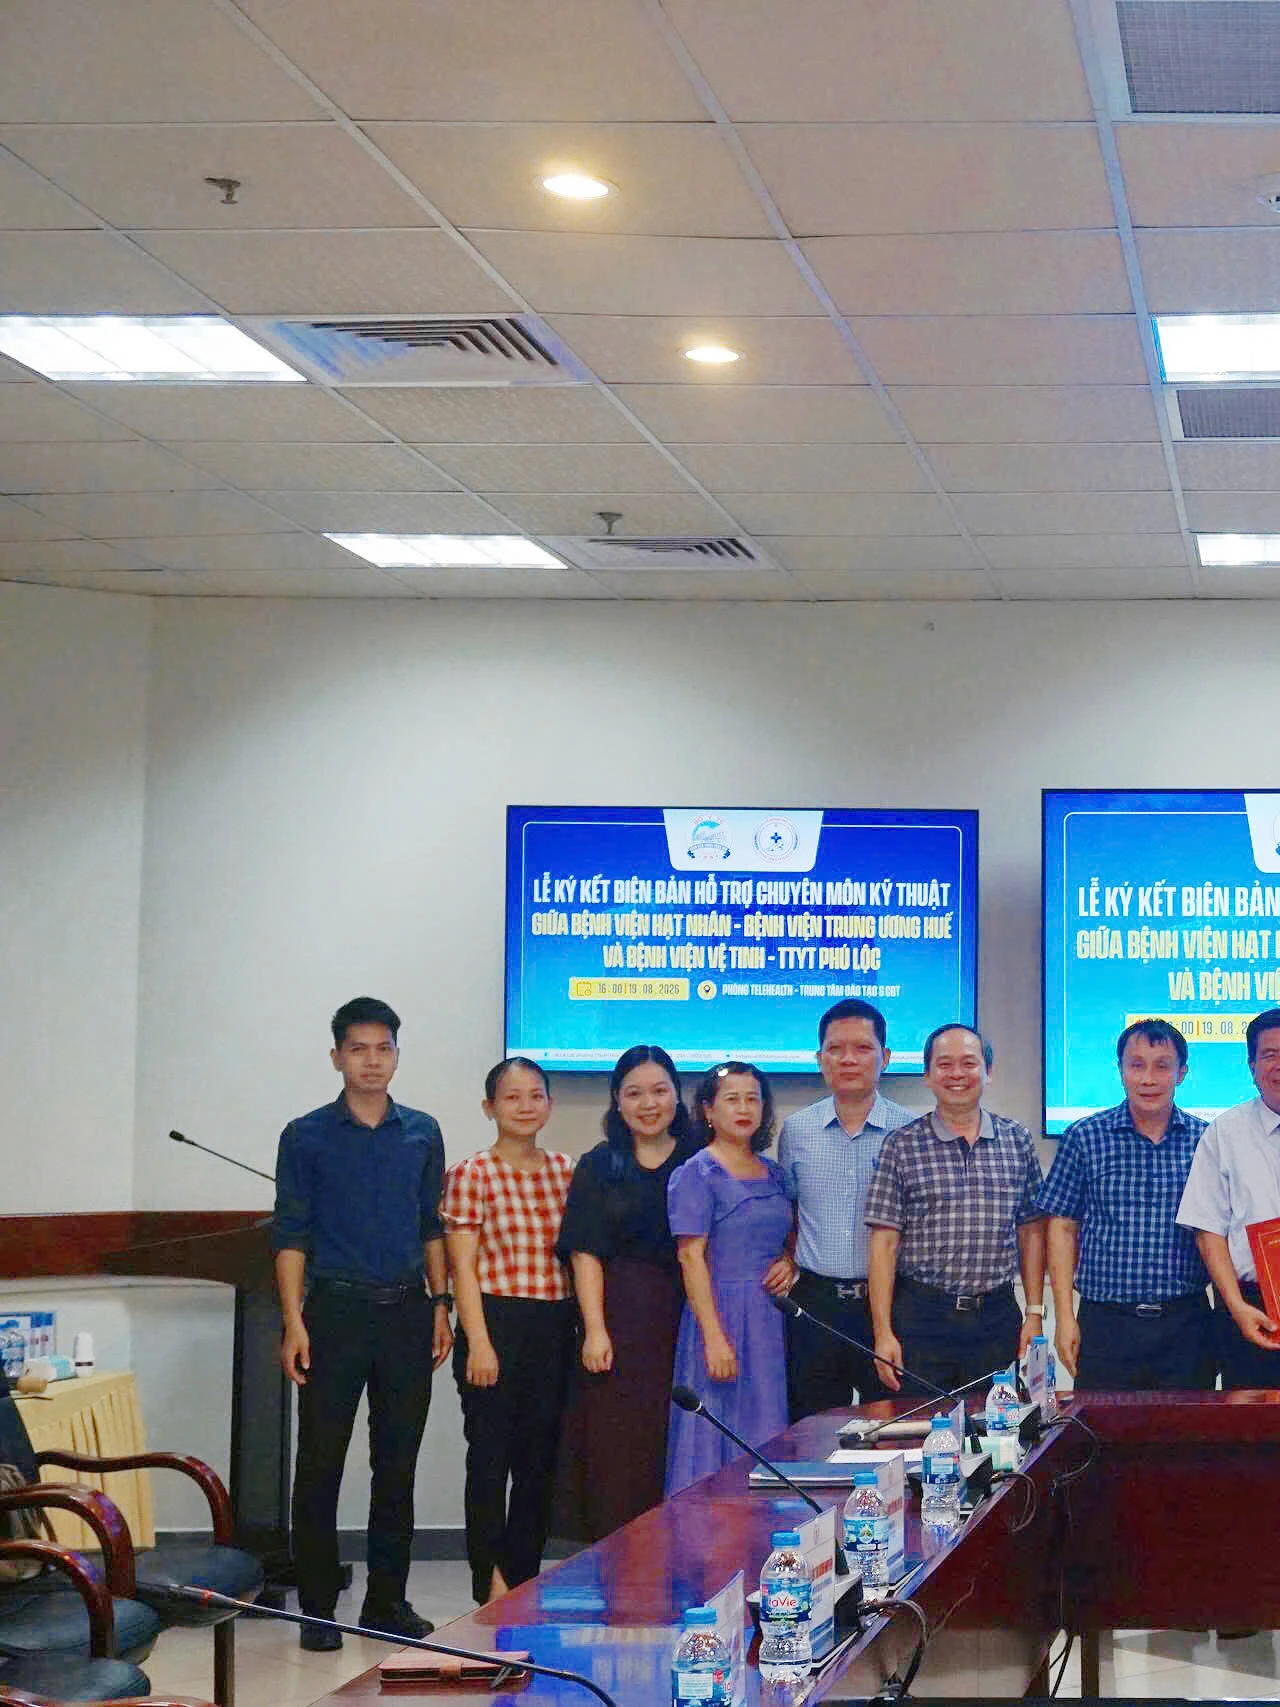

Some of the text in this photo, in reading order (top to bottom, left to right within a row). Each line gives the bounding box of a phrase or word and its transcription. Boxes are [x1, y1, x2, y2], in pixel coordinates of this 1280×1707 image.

[533, 872, 950, 910] LỄ KÝ KẾT BIÊN BẢN HỖ TRỢ CHUYÊN MÔN KỸ THUẬT
[1078, 877, 1100, 917] LỄ
[1105, 881, 1133, 917] KÝ
[1138, 879, 1177, 917] KẾT
[1181, 881, 1229, 917] BIÊN
[1235, 880, 1280, 917] BẢN
[531, 909, 569, 936] GIỮA
[571, 909, 612, 939] BỆNH
[614, 909, 650, 940] VIỆN
[652, 914, 684, 940] HẠT
[685, 910, 732, 937] NHÂN
[744, 911, 785, 941] BỆNH
[787, 912, 822, 941] VIỆN
[824, 916, 875, 938] TRUNG
[878, 914, 921, 939] ƯƠNG
[923, 911, 954, 939] HUẾ
[603, 942, 624, 969] VÀ
[626, 942, 667, 972] BỆNH
[669, 942, 705, 972] VIỆN
[707, 943, 727, 972] VỆ
[728, 946, 766, 969] TINH
[778, 947, 816, 970] TTYT
[818, 944, 850, 970] PHÚ
[853, 944, 881, 974] LỘC
[1076, 926, 1123, 959] GIỮA
[1127, 925, 1179, 964] BỆNH
[1182, 925, 1228, 964] VIỆN
[1231, 930, 1272, 964] HẠT
[1168, 967, 1195, 1001] VÀ
[1199, 967, 1250, 1005] BỆNH
